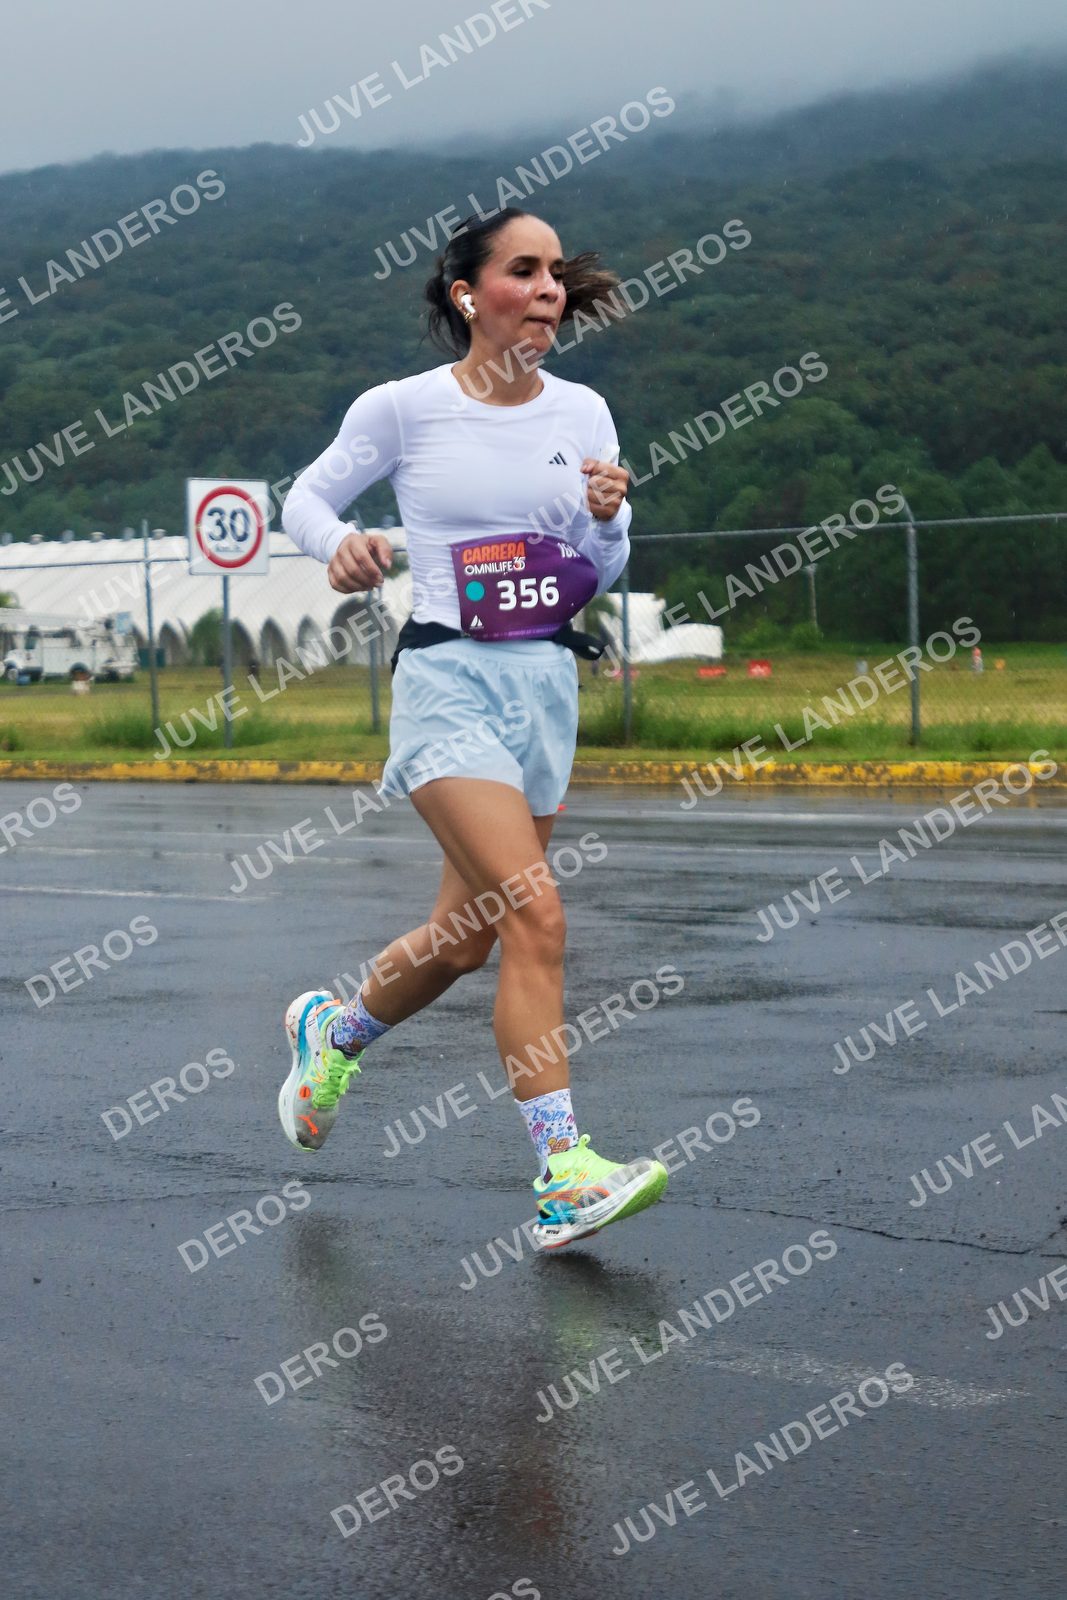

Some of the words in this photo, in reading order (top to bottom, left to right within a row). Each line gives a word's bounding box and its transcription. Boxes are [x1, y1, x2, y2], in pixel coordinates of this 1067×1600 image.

[207, 507, 250, 542] 30
[463, 541, 525, 564] CARRERA
[496, 576, 560, 611] 356
